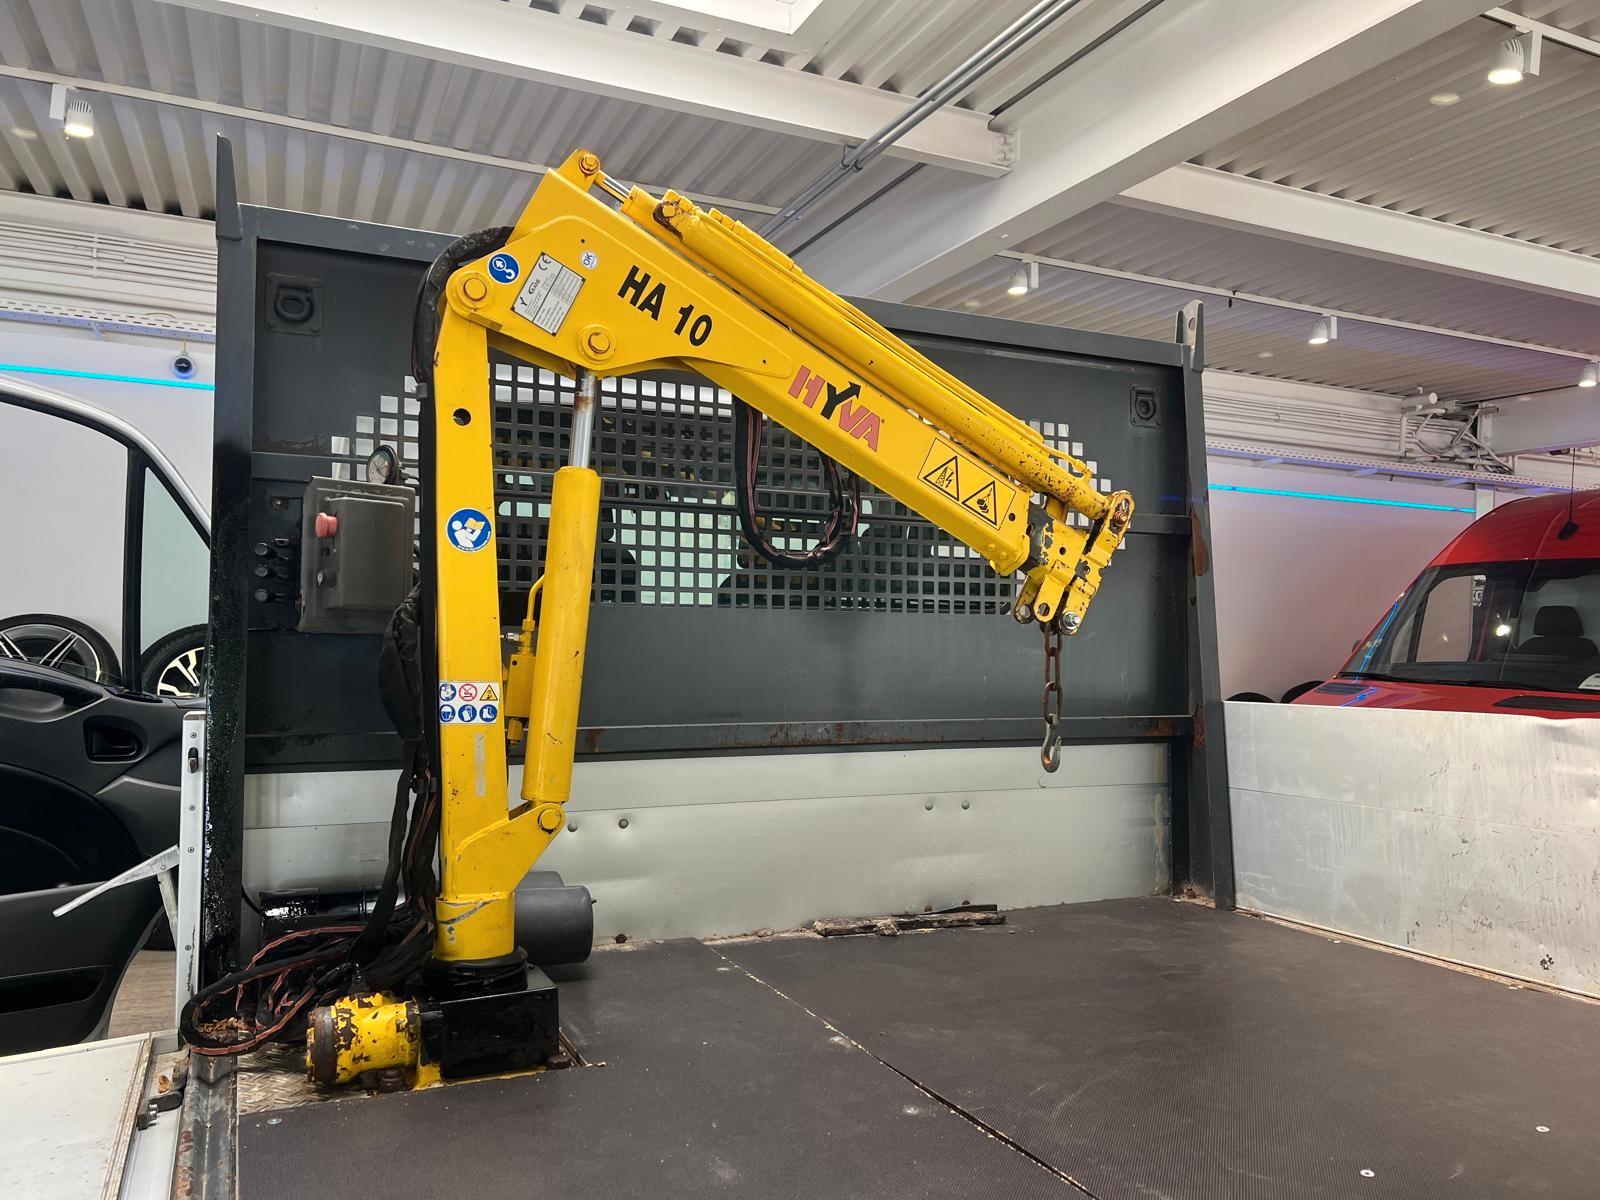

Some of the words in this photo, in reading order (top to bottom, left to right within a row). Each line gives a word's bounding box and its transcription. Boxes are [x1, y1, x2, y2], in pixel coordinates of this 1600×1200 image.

[538, 255, 552, 270] CE
[582, 252, 593, 266] OK
[617, 264, 666, 321] HA
[673, 303, 713, 347] 10
[788, 364, 881, 453] HYVA
